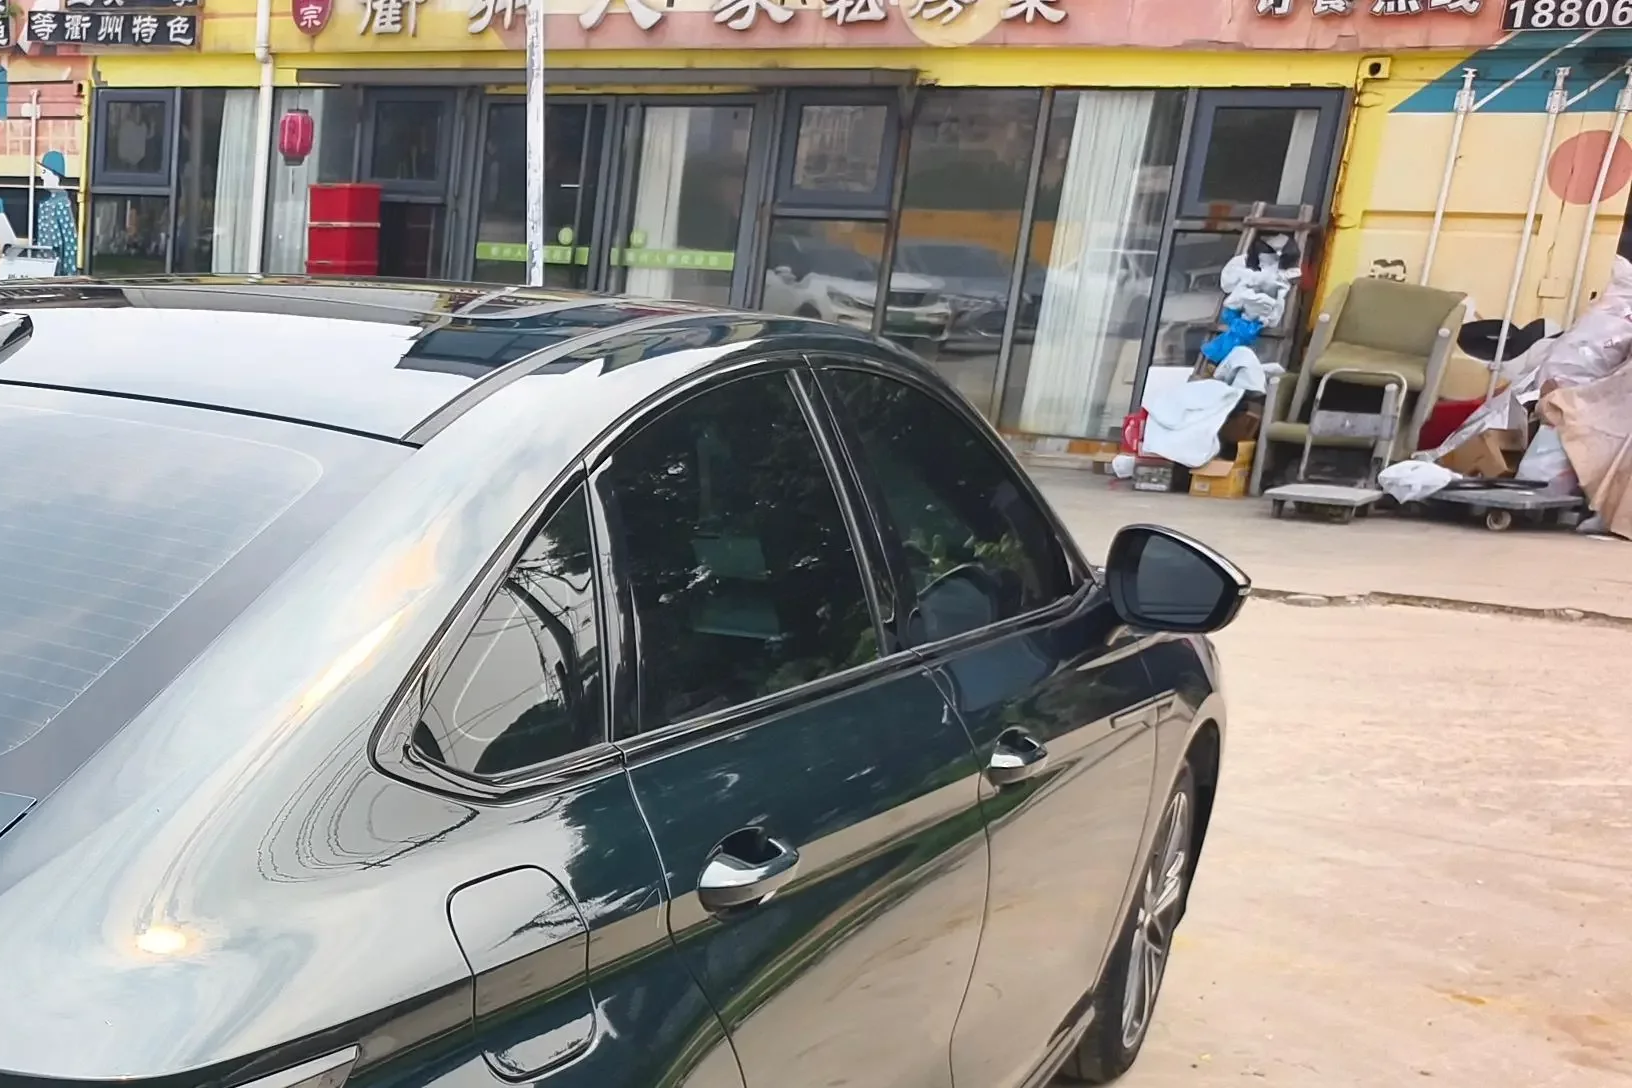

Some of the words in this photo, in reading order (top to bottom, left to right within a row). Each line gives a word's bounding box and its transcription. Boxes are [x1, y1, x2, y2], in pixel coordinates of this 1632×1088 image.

[31, 13, 195, 46] 等衢州特色
